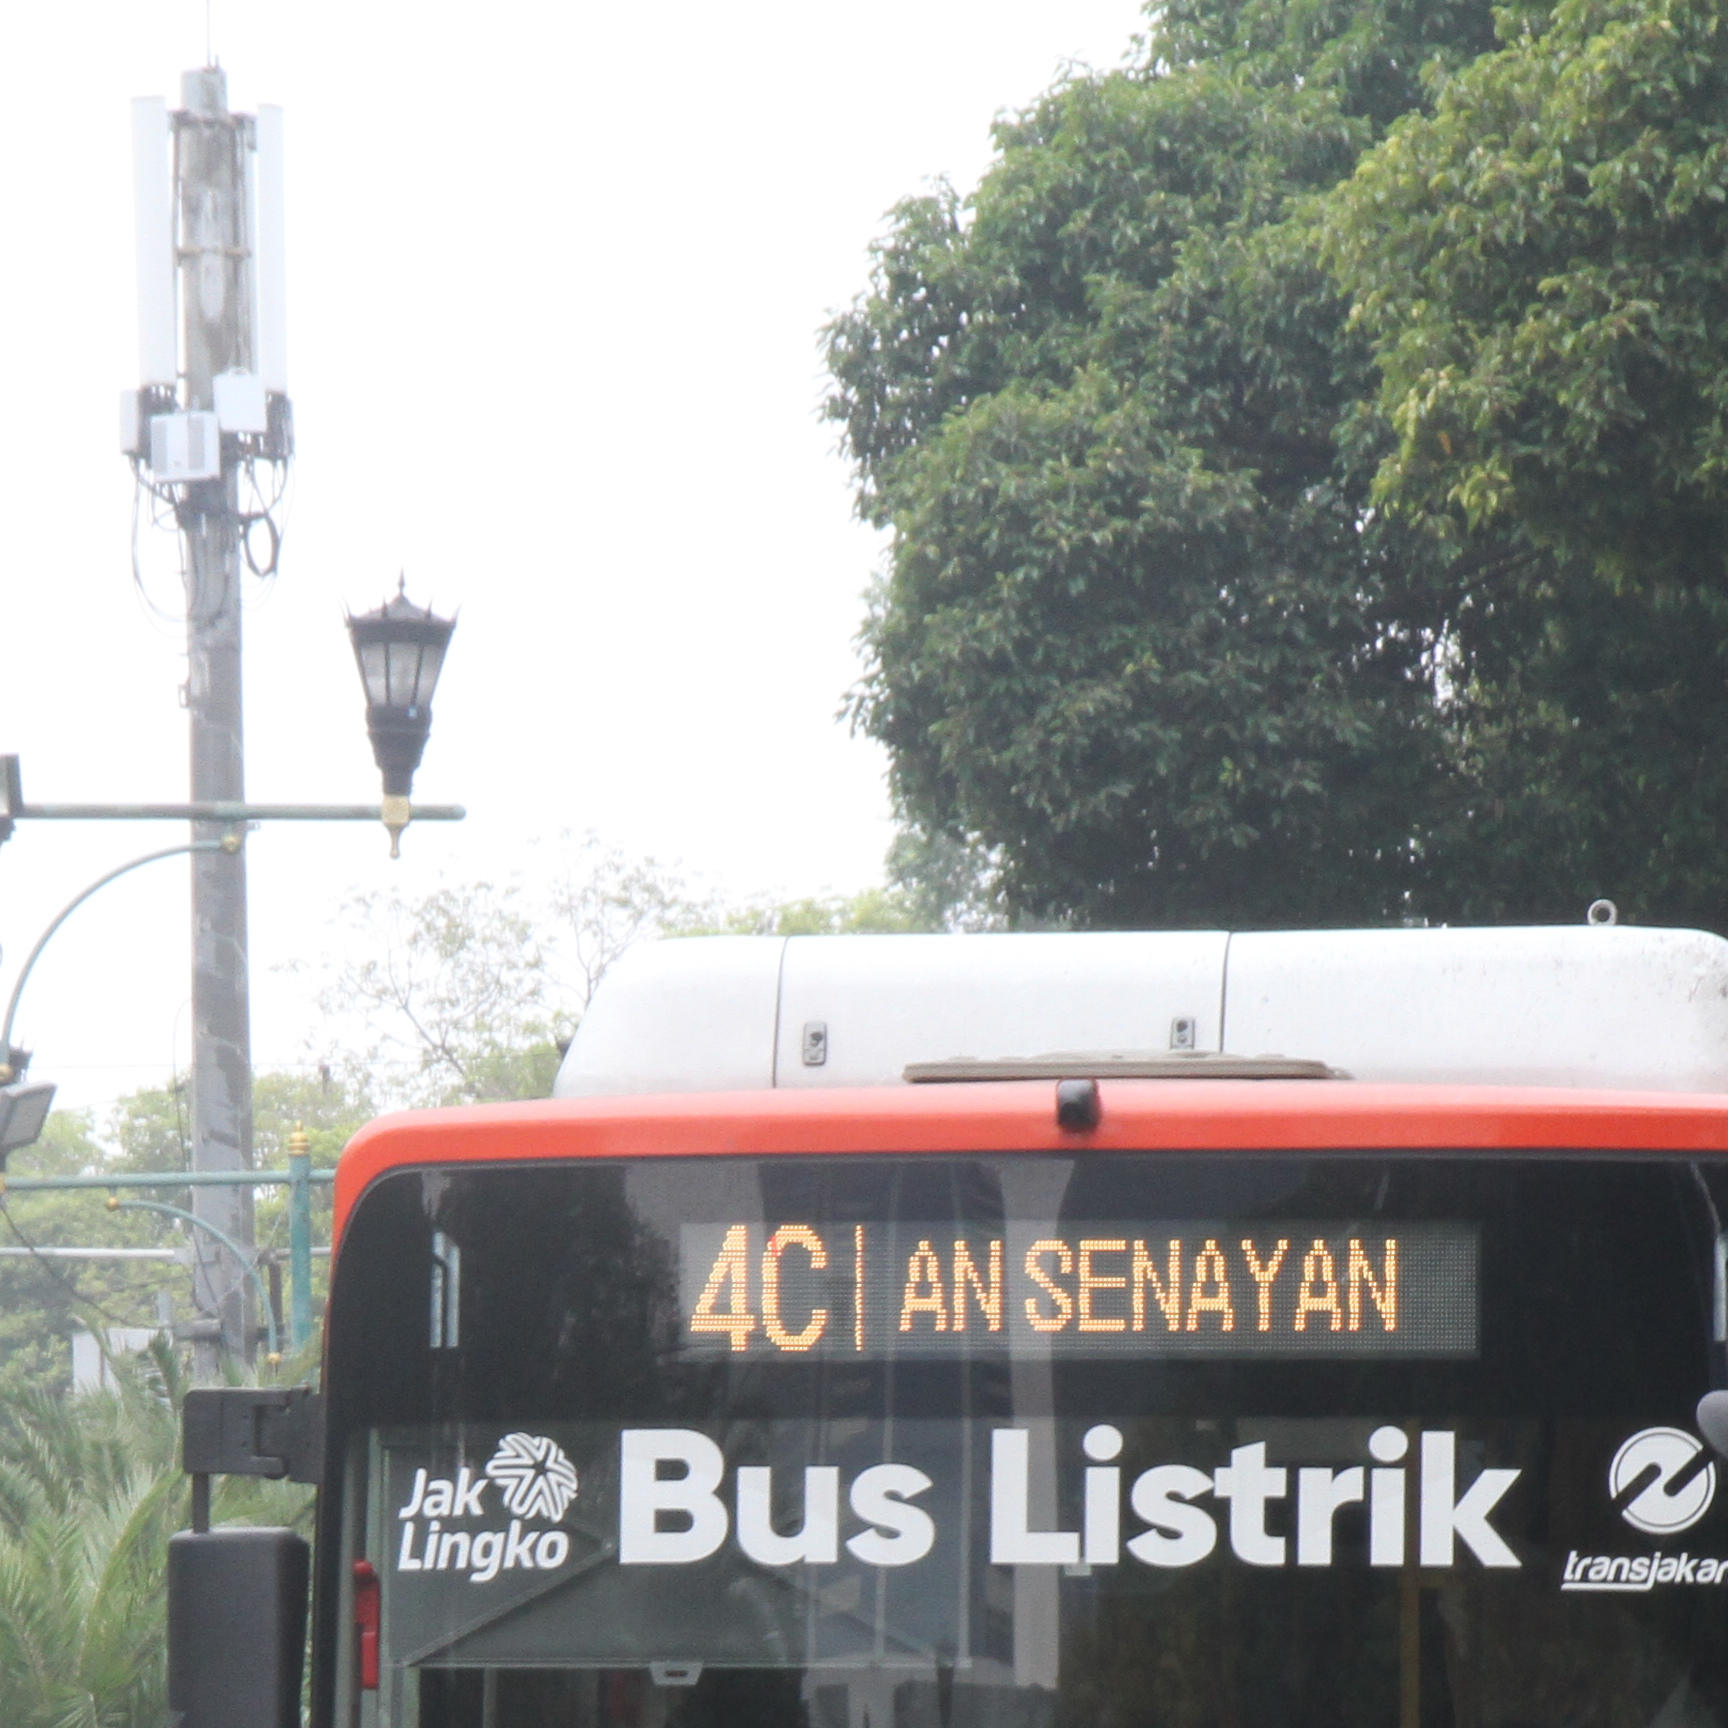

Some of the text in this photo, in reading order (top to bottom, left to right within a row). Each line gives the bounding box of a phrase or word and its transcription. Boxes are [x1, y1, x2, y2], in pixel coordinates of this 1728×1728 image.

[690, 1224, 828, 1351] 4C
[898, 1239, 1397, 1331] AN SENAYAN
[398, 1467, 489, 1519] Jak
[620, 1424, 1522, 1568] Bus Listrik
[398, 1519, 570, 1582] Lingko
